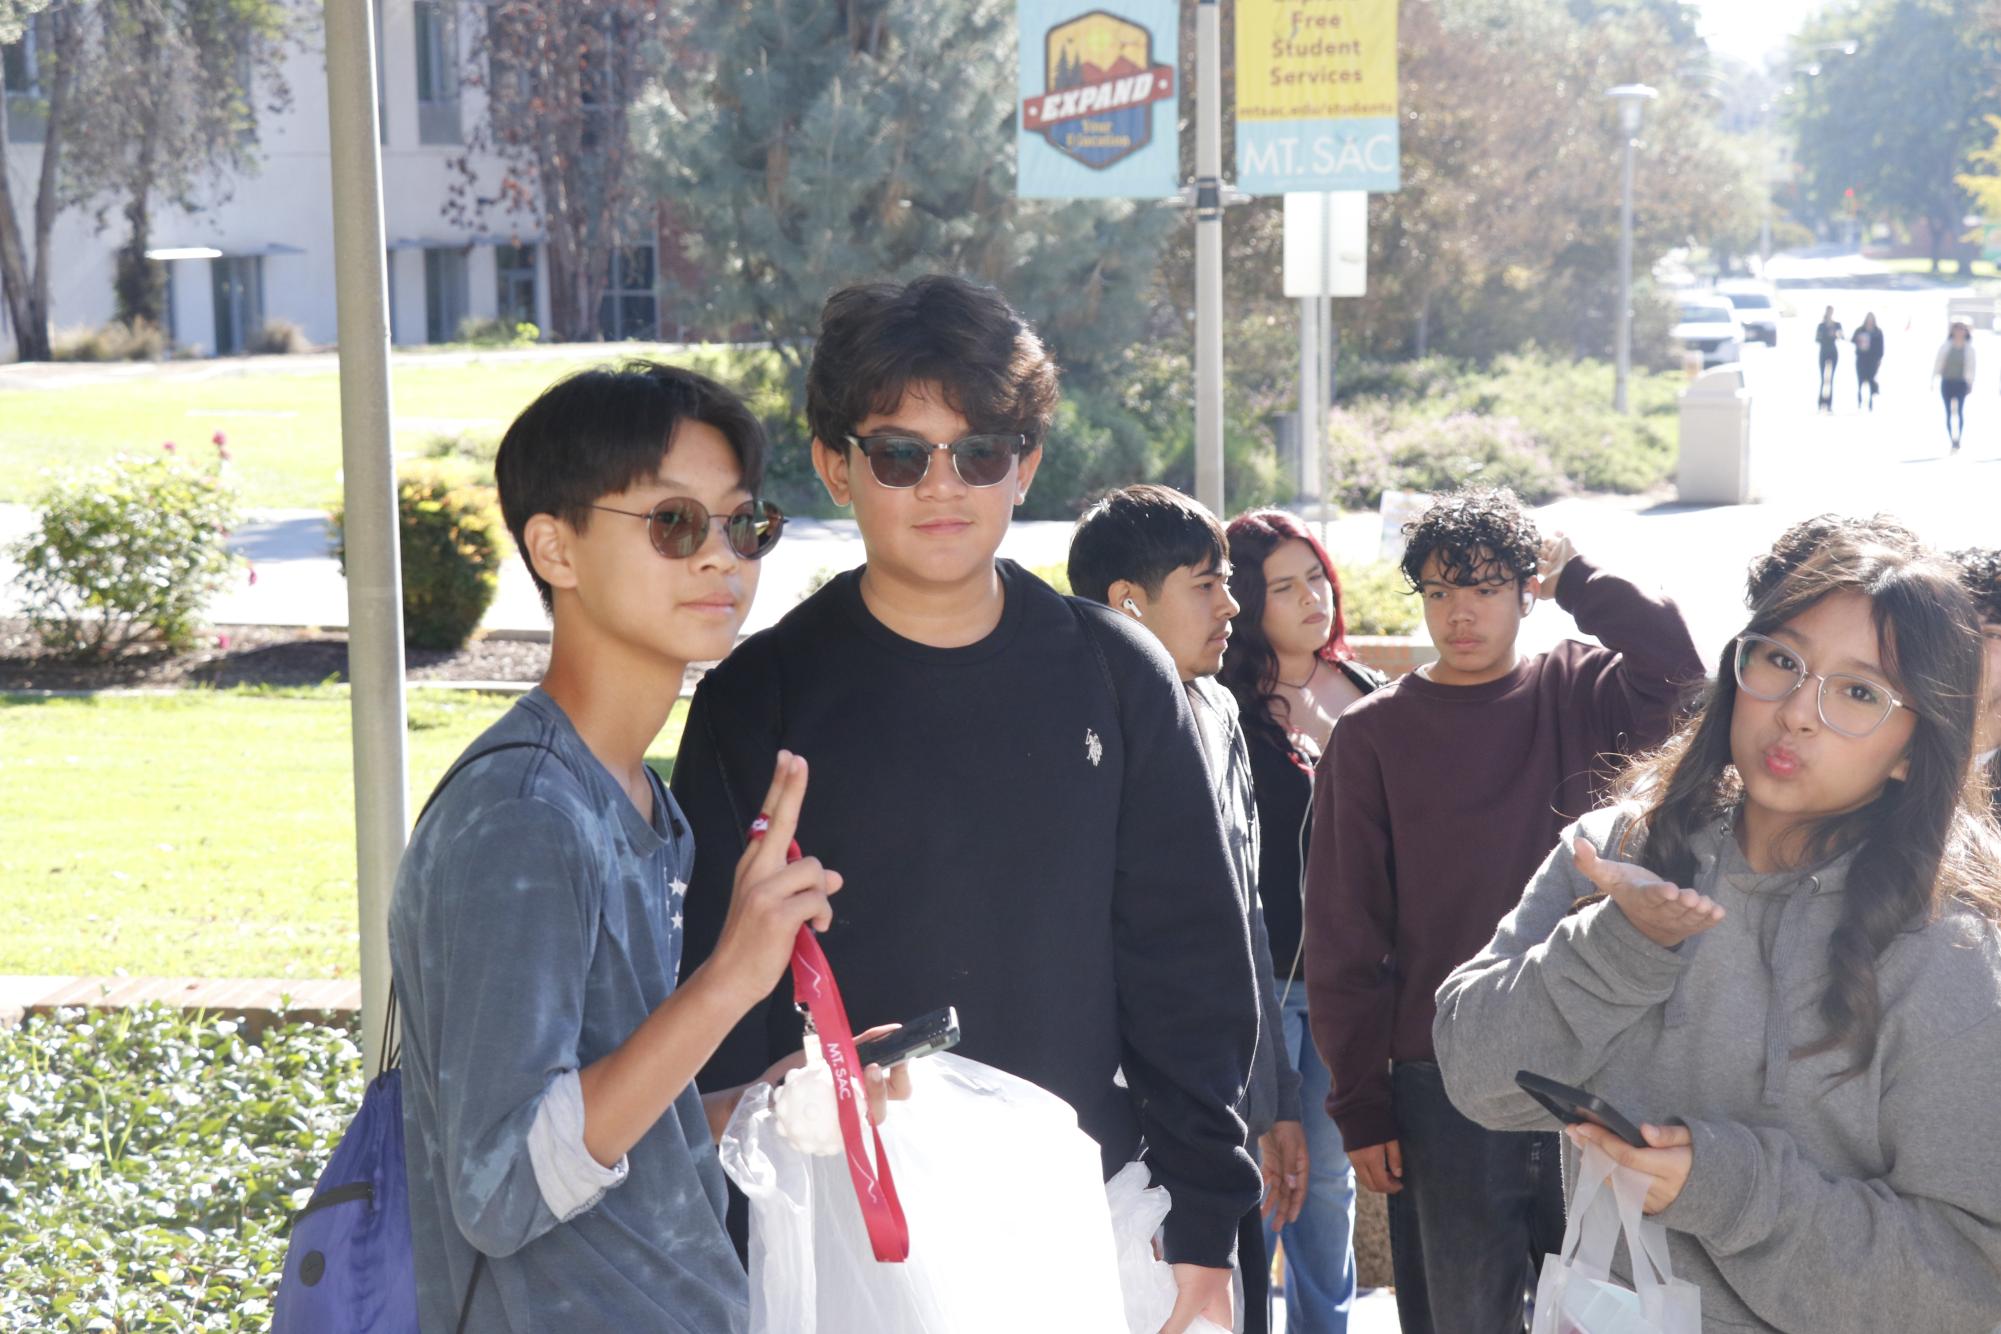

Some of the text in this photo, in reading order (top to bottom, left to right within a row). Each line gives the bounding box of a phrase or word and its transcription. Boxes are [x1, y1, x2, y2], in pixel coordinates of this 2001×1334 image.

[1292, 11, 1341, 28] Free
[1273, 37, 1361, 58] Student
[1270, 66, 1362, 86] Services
[1040, 73, 1154, 122] EXPAND
[1242, 134, 1393, 176] MT. SAC
[827, 1043, 852, 1101] MT. SAC
